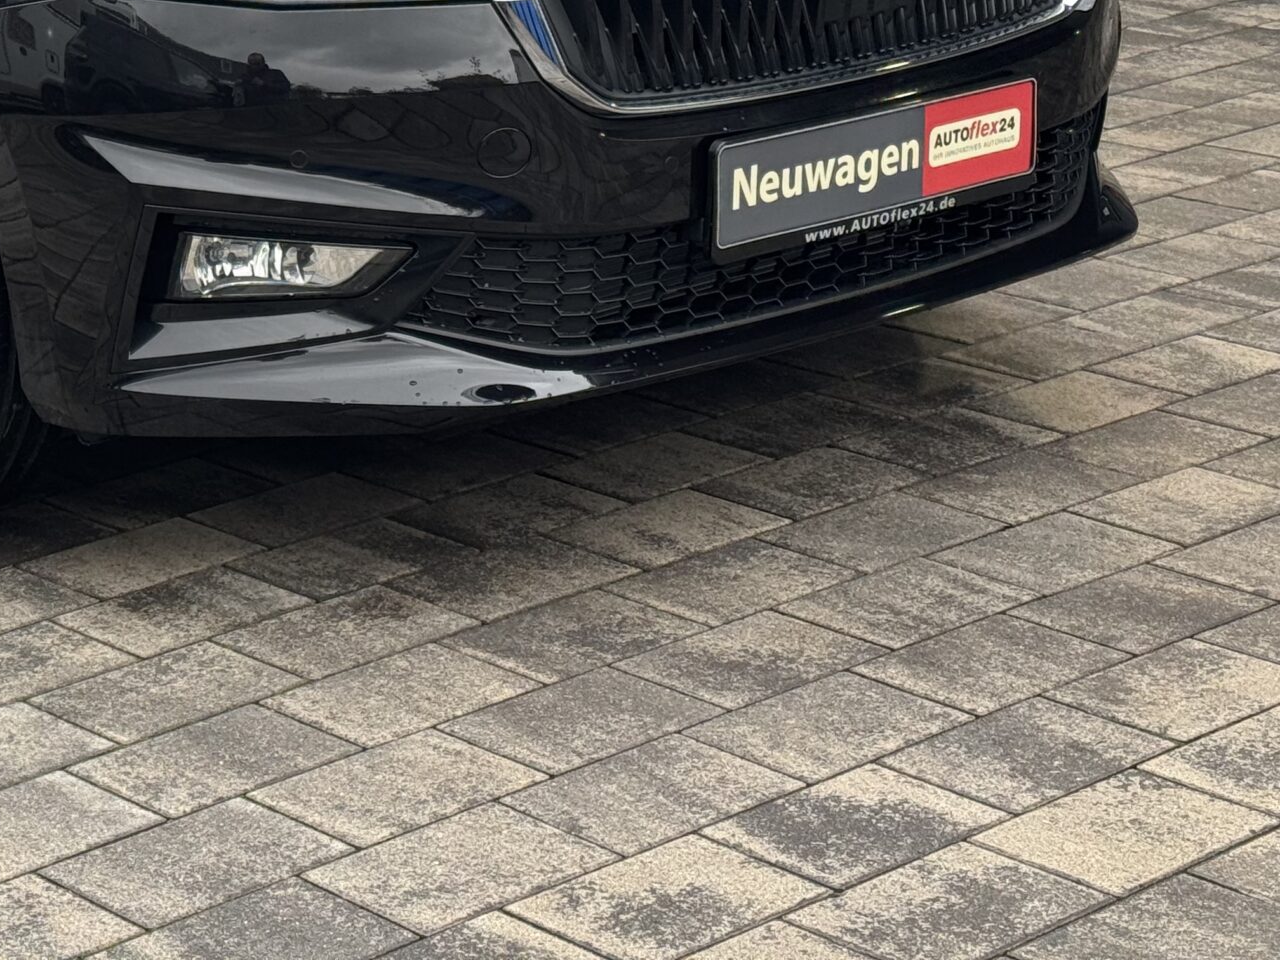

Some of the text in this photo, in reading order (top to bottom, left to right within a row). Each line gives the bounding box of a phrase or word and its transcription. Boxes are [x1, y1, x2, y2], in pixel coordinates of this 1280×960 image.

[933, 115, 1016, 149] AUTOflex24
[731, 138, 920, 211] Neuwagen
[804, 195, 956, 243] www.AUTOflex24.de
